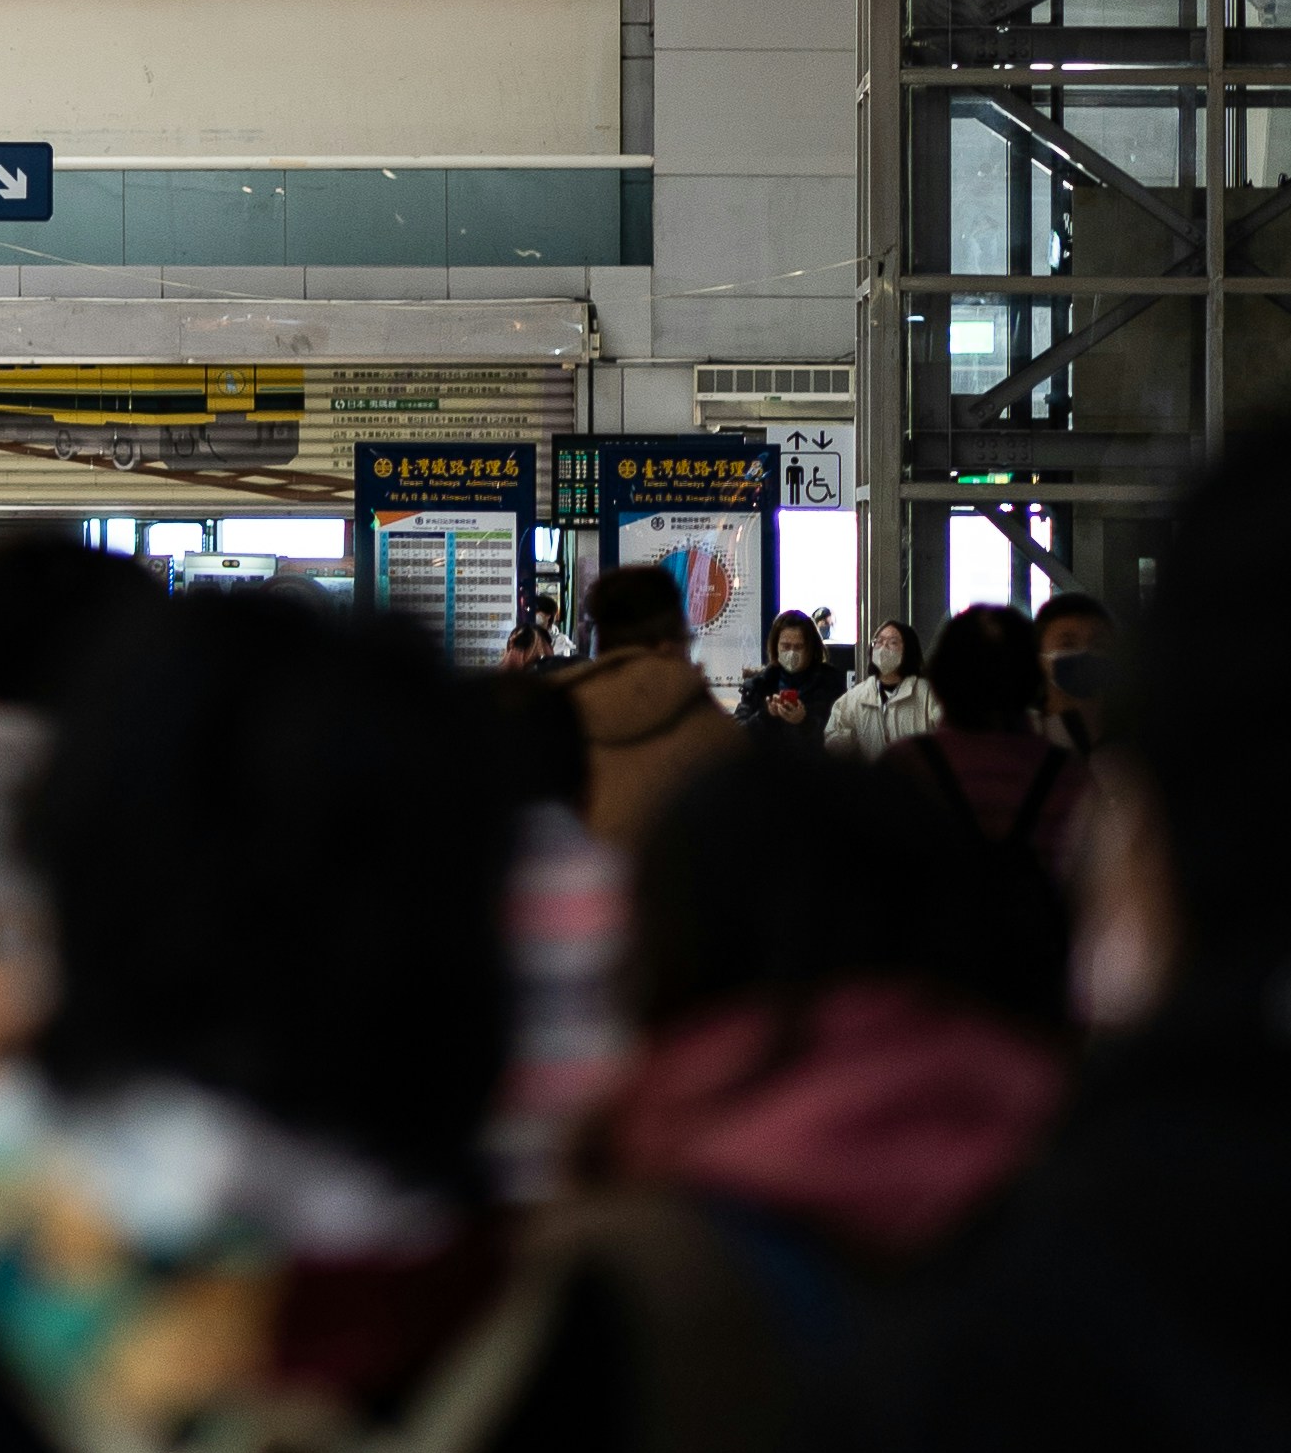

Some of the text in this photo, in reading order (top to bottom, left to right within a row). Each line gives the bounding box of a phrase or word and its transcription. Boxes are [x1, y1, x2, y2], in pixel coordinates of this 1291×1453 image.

[397, 457, 520, 479] 臺灣鐵路管理局
